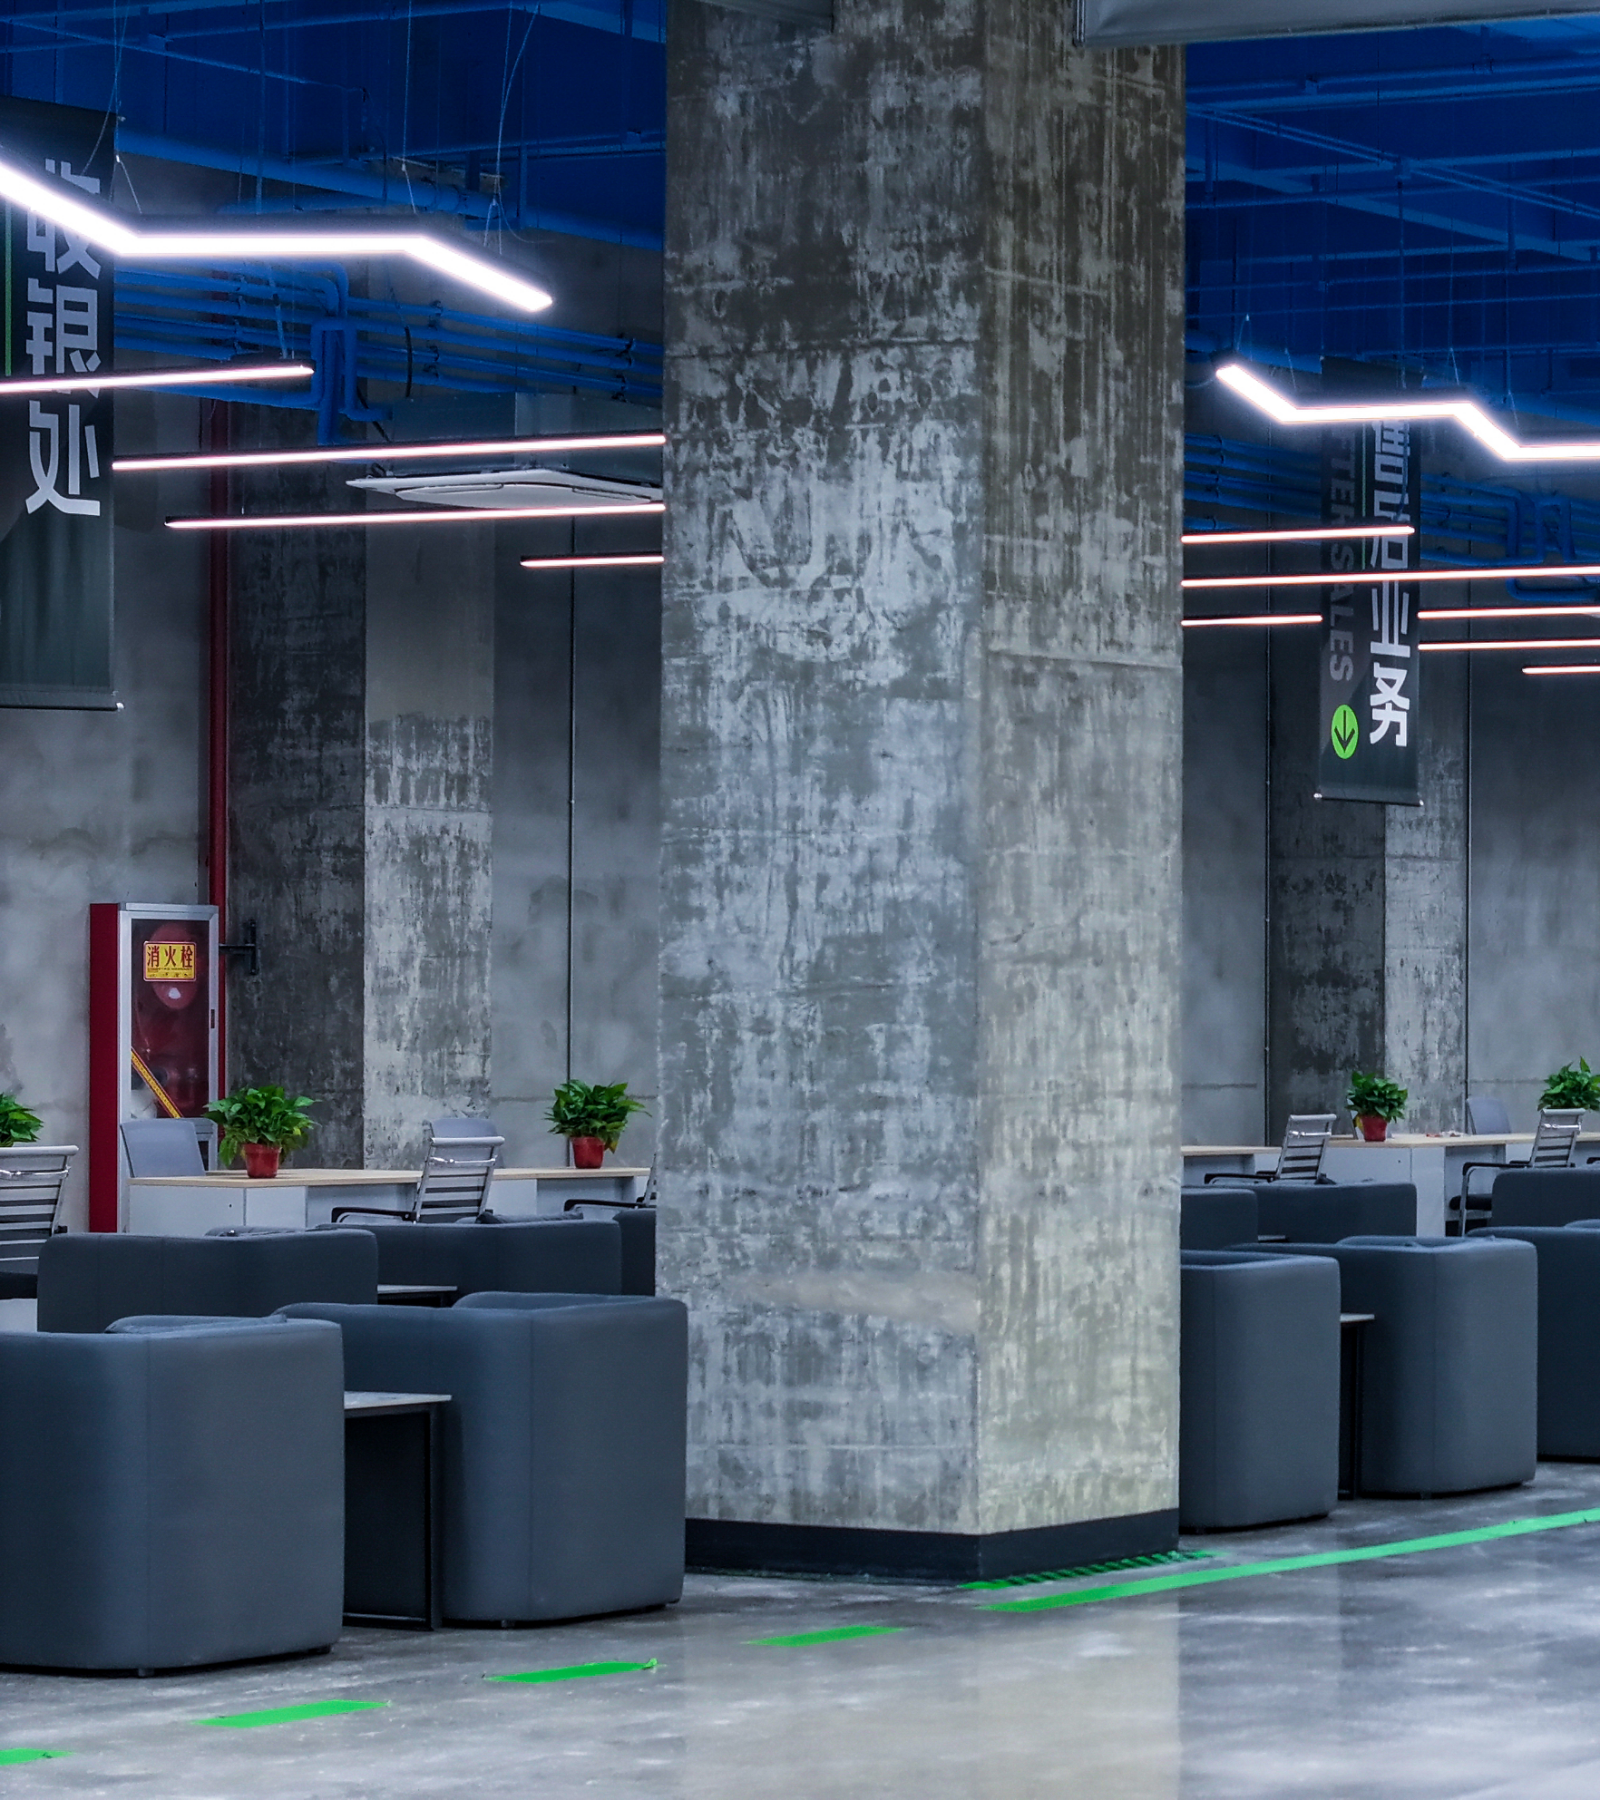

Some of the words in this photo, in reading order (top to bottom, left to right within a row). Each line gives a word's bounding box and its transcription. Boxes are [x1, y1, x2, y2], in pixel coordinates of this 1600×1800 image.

[25, 157, 101, 517] 收银处
[1329, 420, 1355, 528] FTER
[1369, 414, 1411, 748] 售后业务
[147, 945, 193, 968] 消火栓
